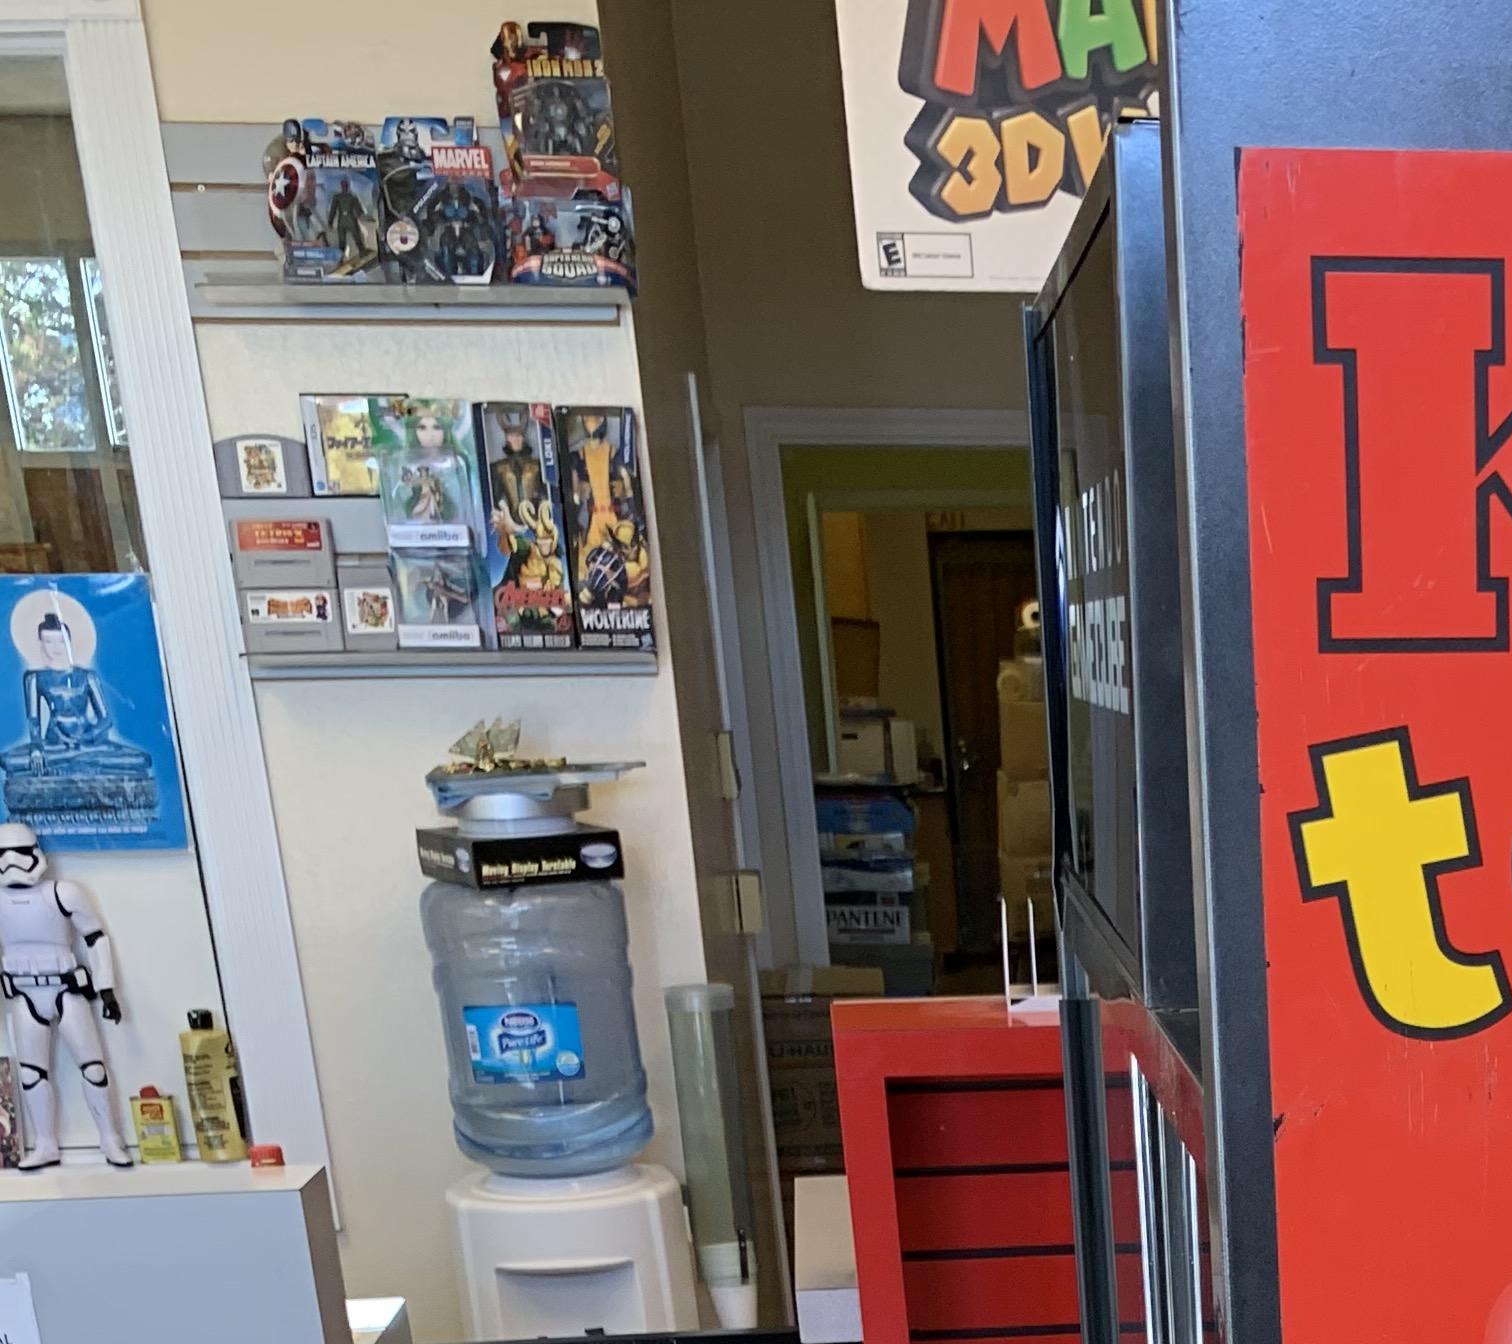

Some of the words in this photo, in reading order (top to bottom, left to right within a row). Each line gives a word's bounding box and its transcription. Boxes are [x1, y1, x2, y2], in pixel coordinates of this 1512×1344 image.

[934, 0, 1158, 95] MA
[305, 153, 339, 168] CAPTAIN
[340, 153, 377, 168] AMERICA
[432, 147, 489, 170] MARVEL
[543, 438, 555, 467] LOKI
[420, 531, 459, 541] amiibo
[580, 608, 650, 630] WOLVERINE
[432, 630, 470, 640] amiibo
